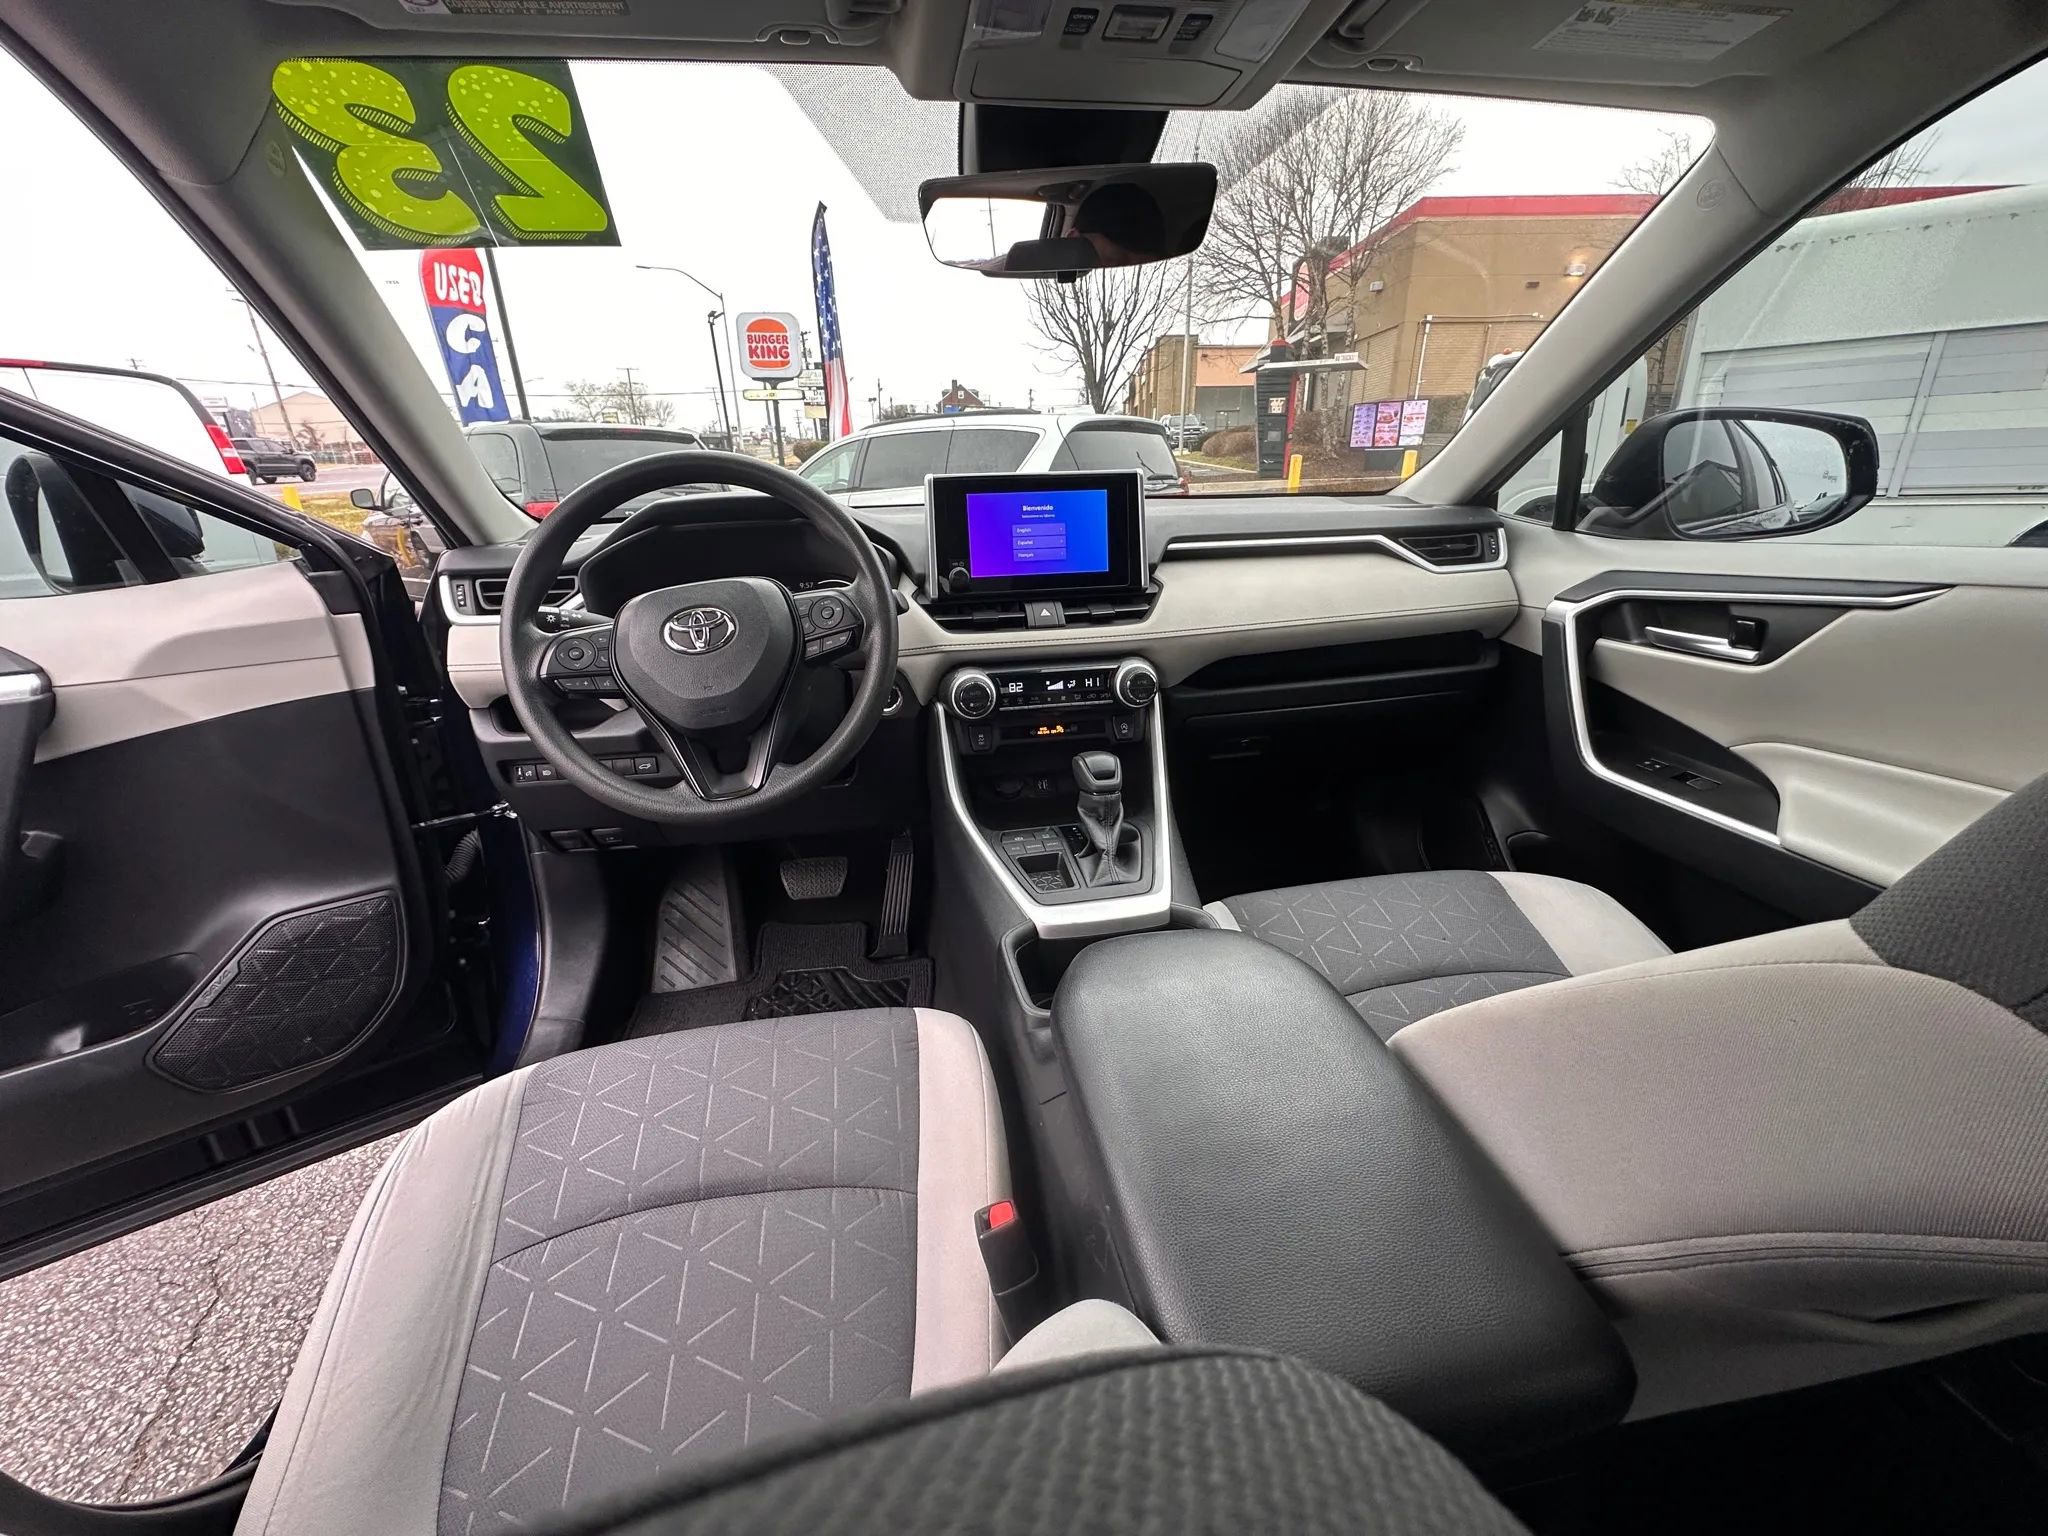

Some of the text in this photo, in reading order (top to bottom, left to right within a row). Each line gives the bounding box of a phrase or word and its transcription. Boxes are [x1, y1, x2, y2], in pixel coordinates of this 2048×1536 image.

[433, 262, 483, 307] USED
[746, 334, 790, 345] BURGER
[748, 345, 790, 359] KING
[446, 313, 507, 425] CA
[1022, 504, 1054, 512] Bienvenido
[1008, 682, 1024, 693] 82
